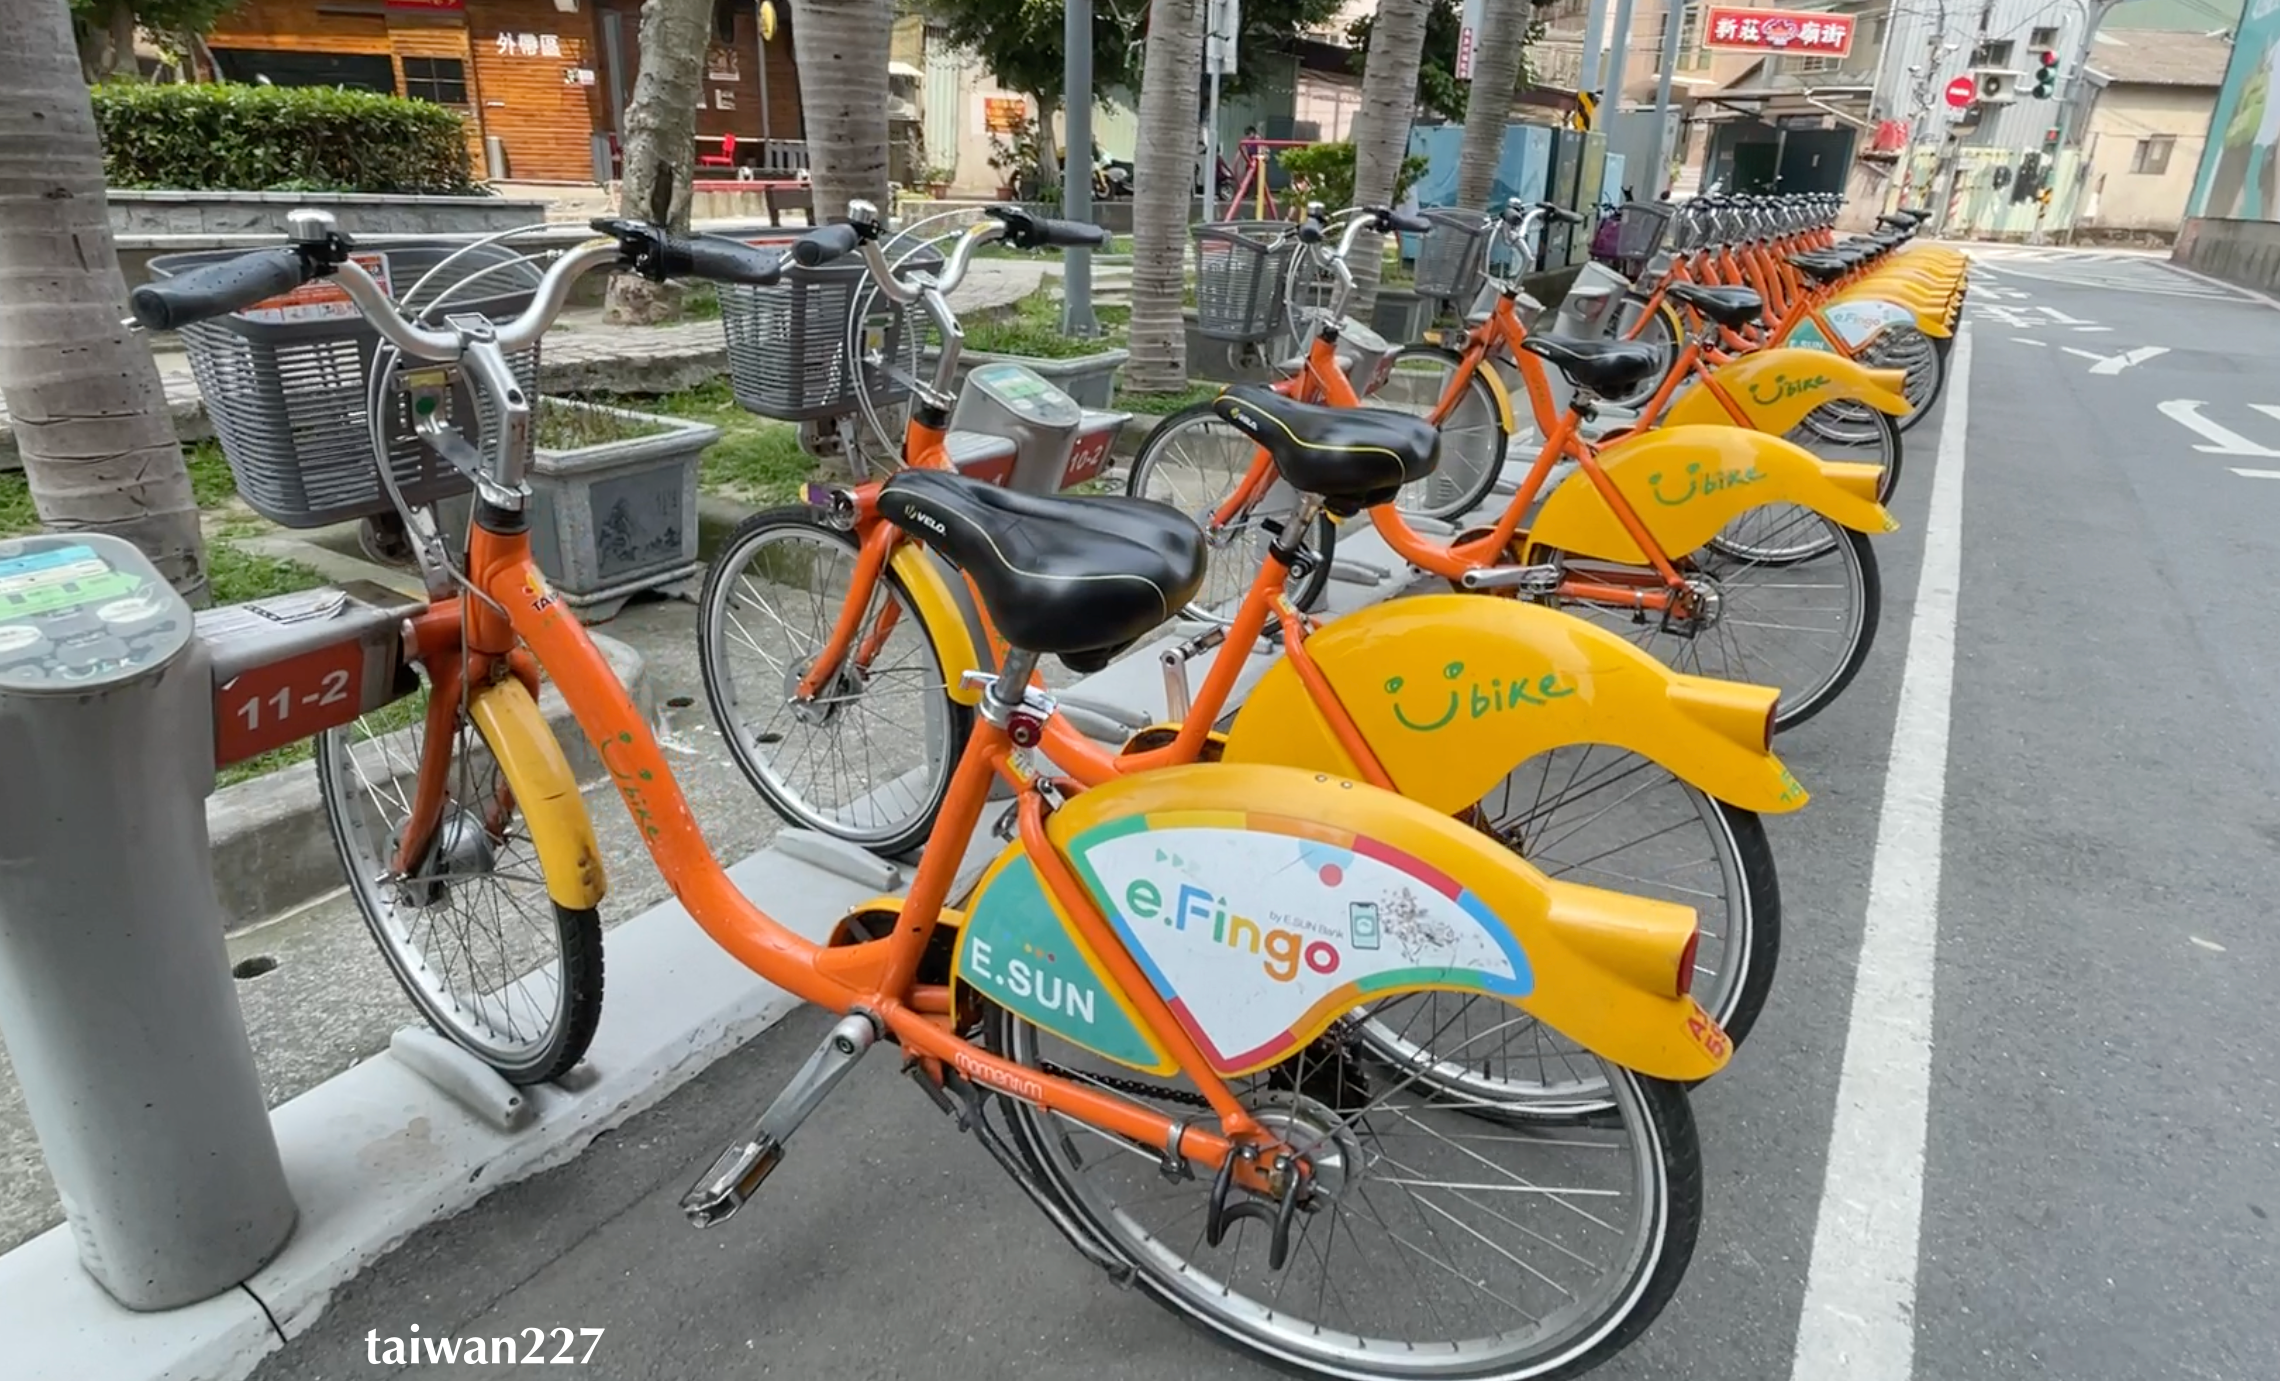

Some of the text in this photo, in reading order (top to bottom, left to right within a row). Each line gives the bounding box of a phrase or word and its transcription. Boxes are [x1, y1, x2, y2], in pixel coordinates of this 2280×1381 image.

[1715, 17, 1761, 42] 新莊
[1069, 444, 1104, 473] 10-2
[917, 511, 946, 534] VELO
[236, 669, 350, 731] 11-2
[1125, 878, 1341, 982] e.Fingo
[1269, 911, 1283, 924] by
[1319, 923, 1344, 939] Bank
[971, 935, 1095, 1024] E.SUN
[954, 1051, 1043, 1099] momentum
